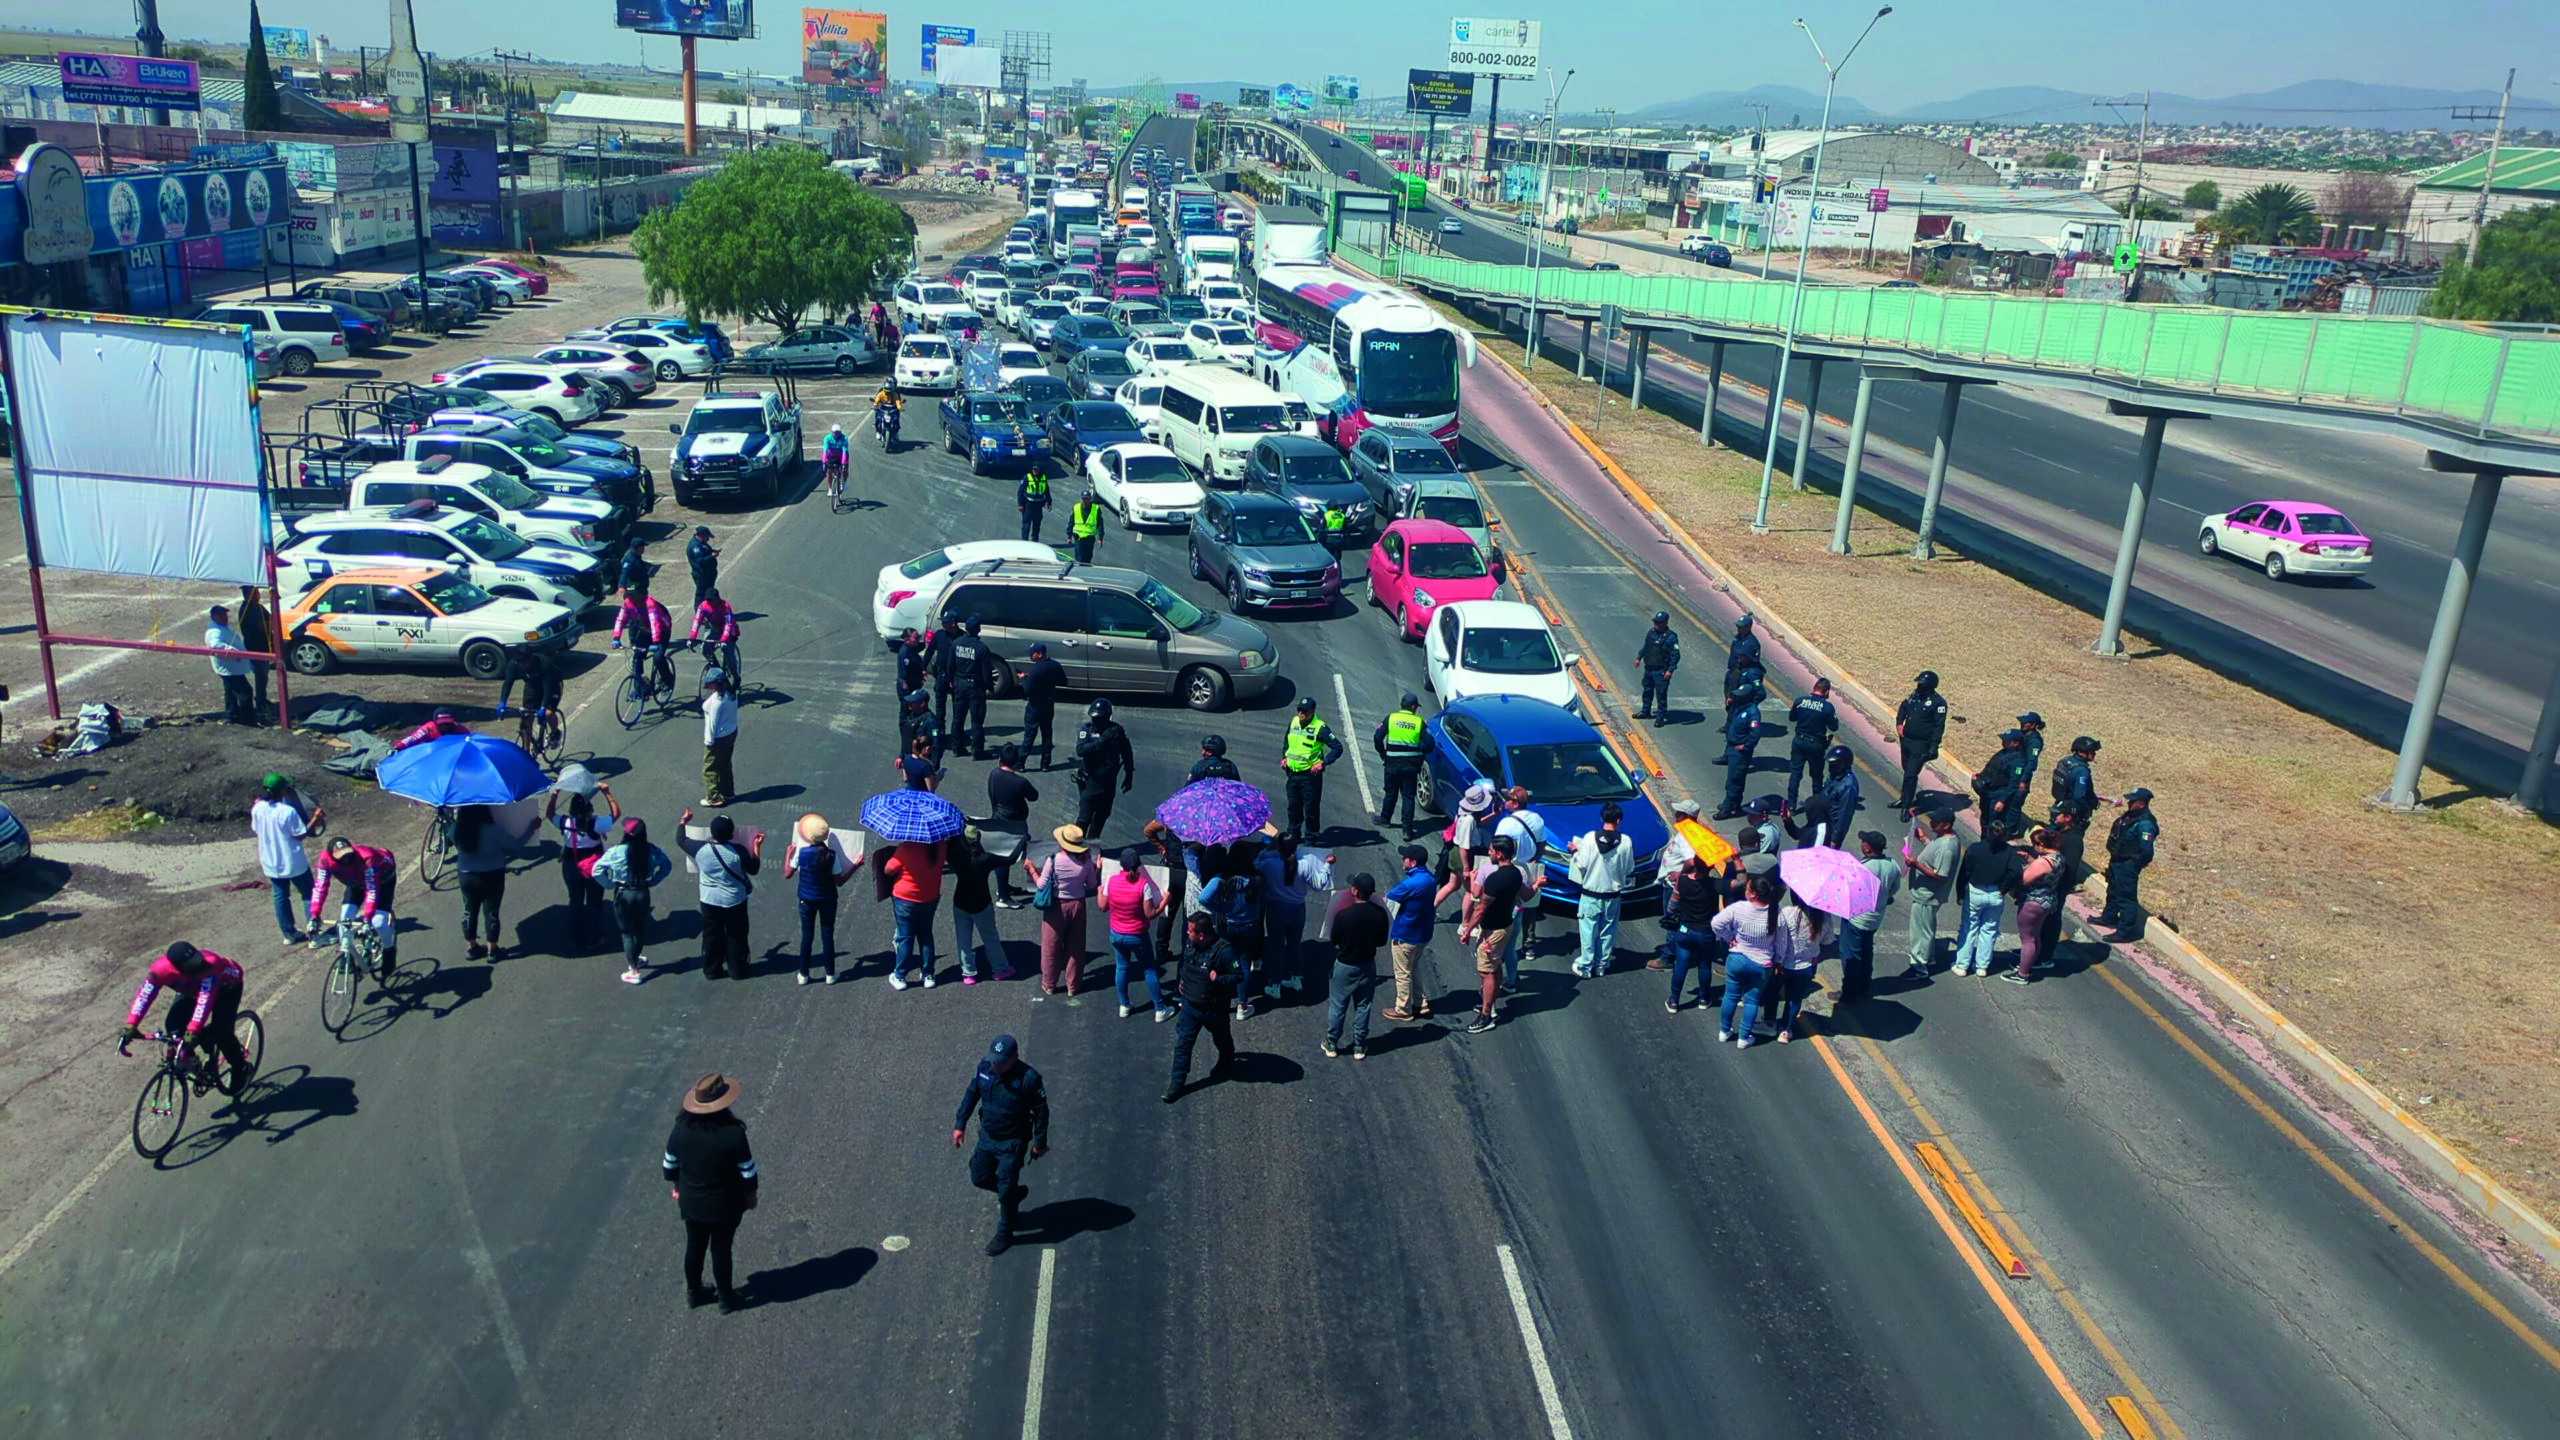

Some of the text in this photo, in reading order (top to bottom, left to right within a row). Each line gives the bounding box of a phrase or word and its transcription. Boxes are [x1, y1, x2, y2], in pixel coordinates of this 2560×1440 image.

[814, 13, 849, 38] Villita
[1485, 26, 1516, 38] cartel
[69, 57, 105, 76] HA
[1450, 51, 1537, 68] 800-002-0022
[1369, 341, 1400, 351] APAN
[395, 627, 424, 639] TAXI
